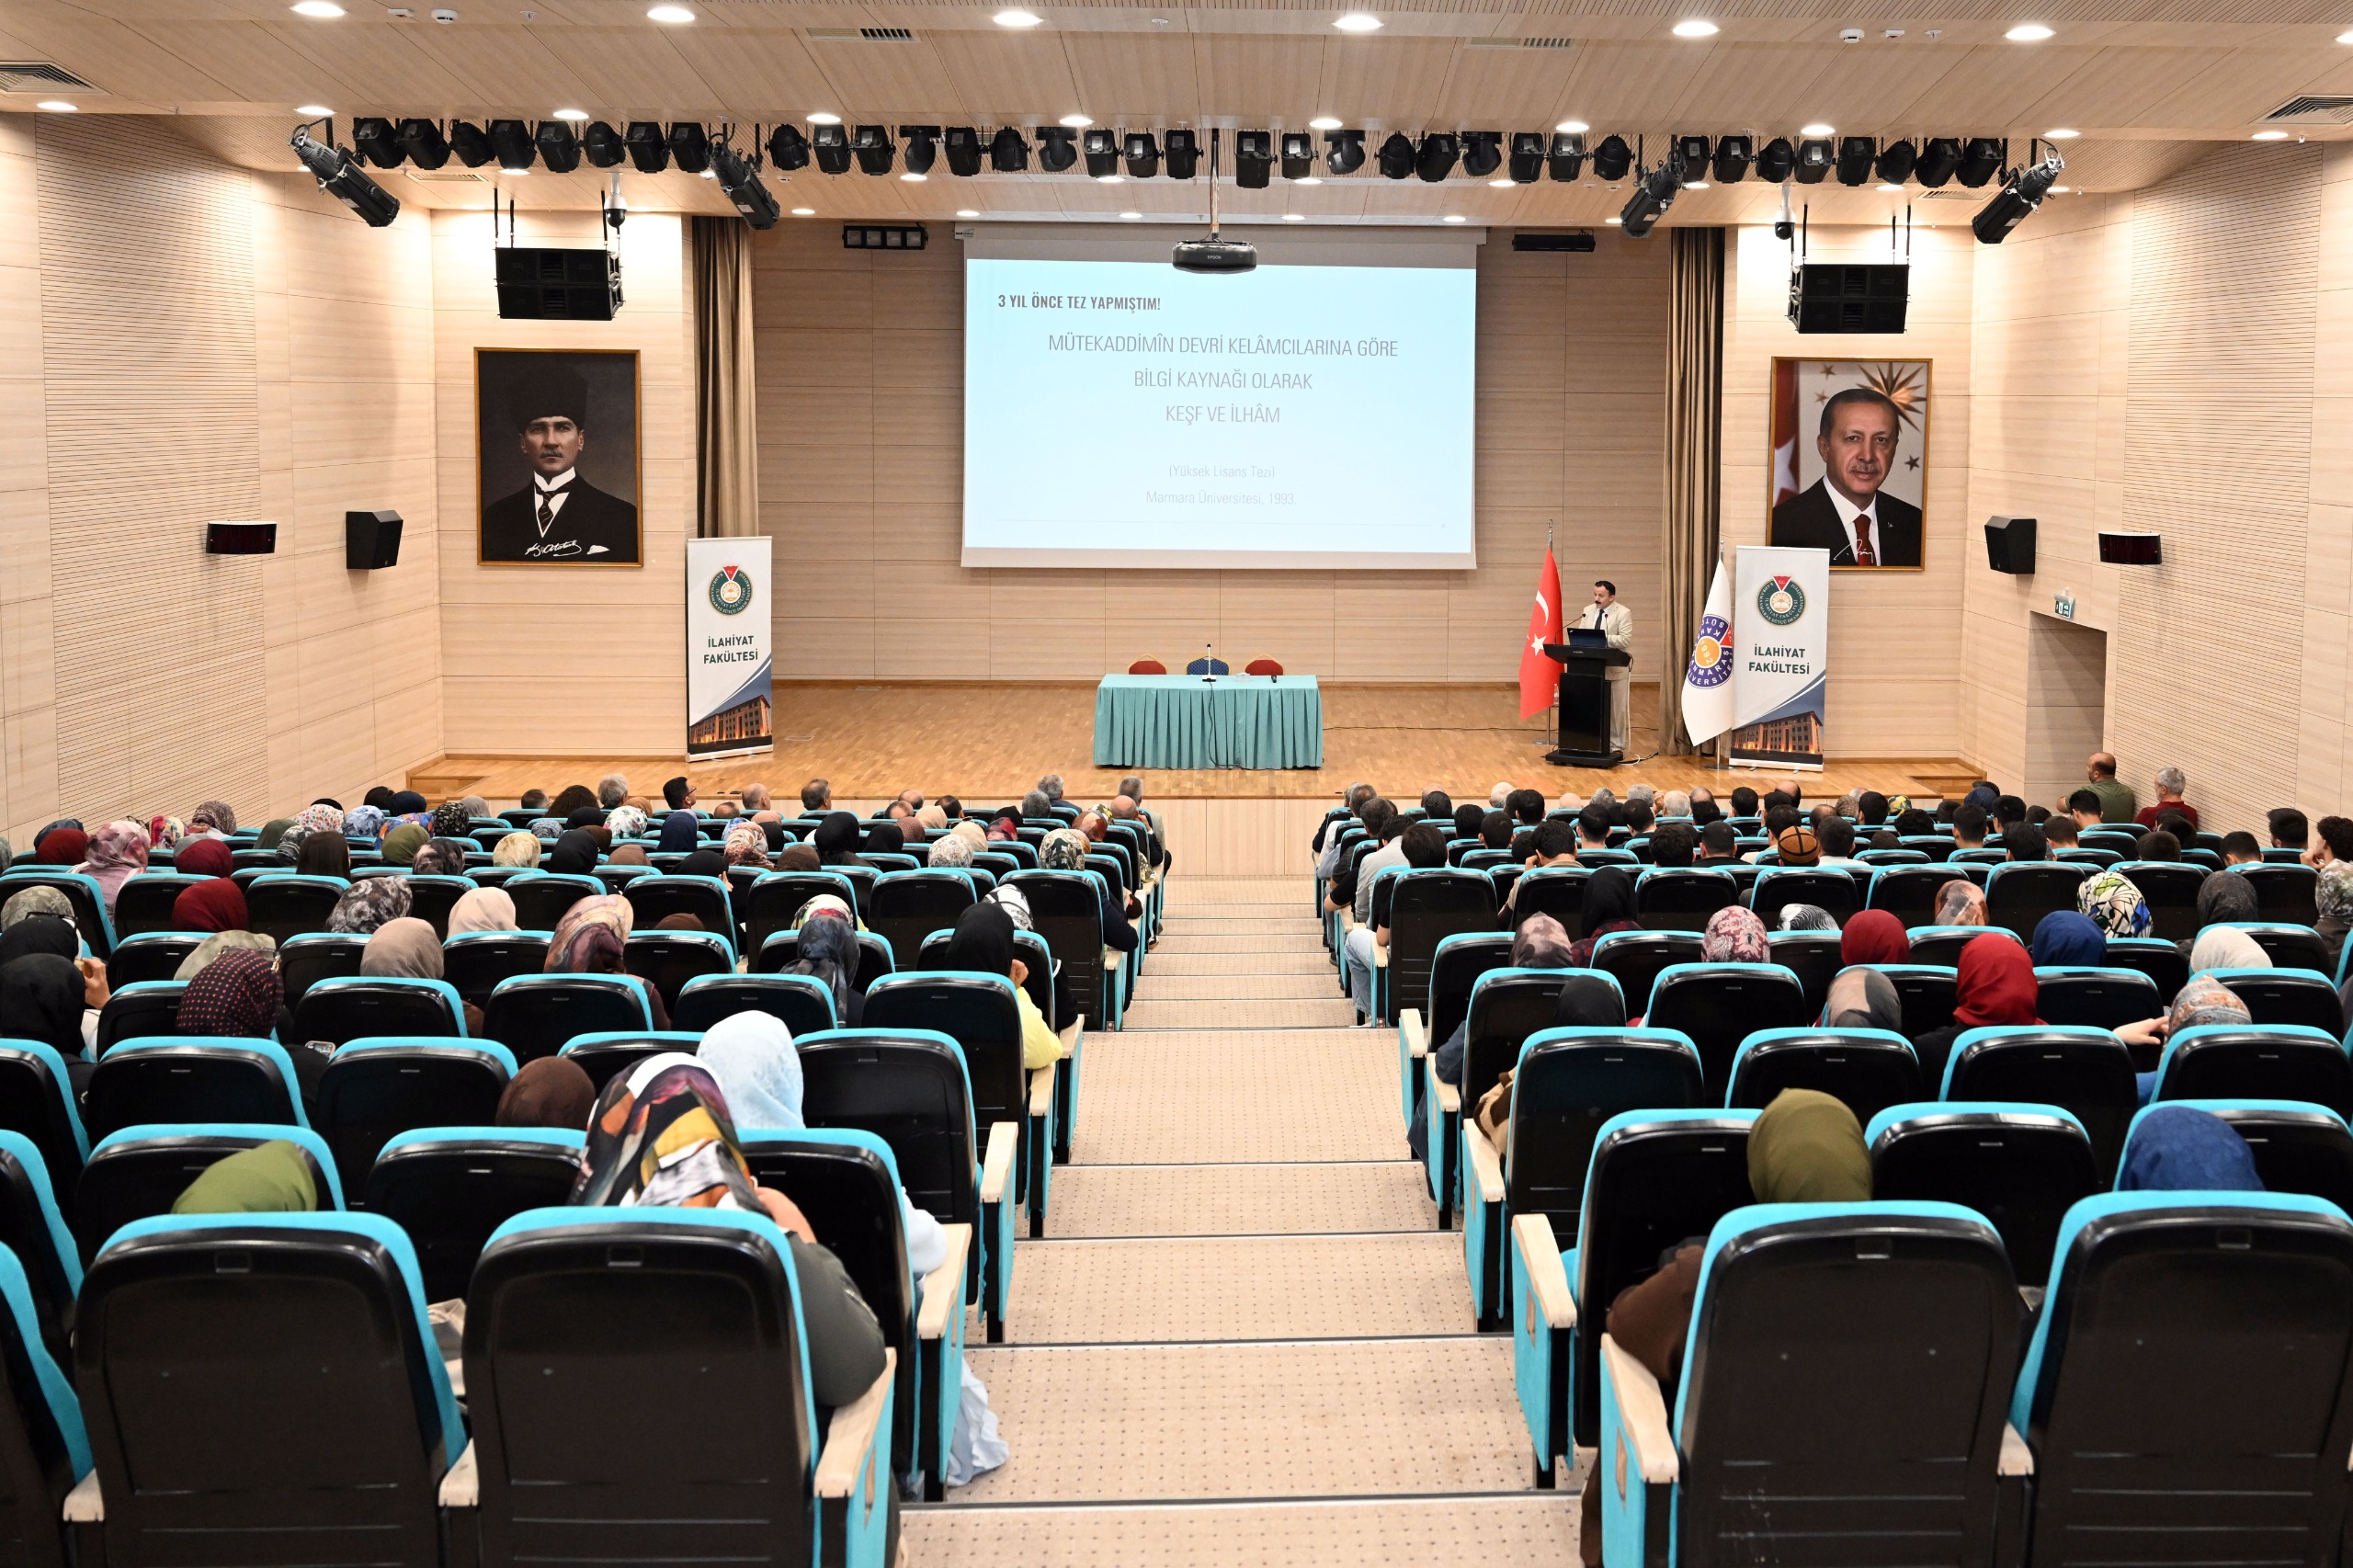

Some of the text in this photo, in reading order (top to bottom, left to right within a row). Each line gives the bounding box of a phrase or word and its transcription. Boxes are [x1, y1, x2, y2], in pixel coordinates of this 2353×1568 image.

[997, 291, 1161, 314] 3 YIL ÖNCE TEZ YAPMIŞTIM!
[1048, 331, 1398, 357] MÜTEKADDİMÎN DEVRİ KELÂMCILARINA GÖRE
[1134, 368, 1313, 390] BİLGİ KAYNAĞI OLARAK
[1165, 403, 1280, 426] KEŞF VE İLHÂM
[1168, 464, 1276, 480] (Yüksek Lisans Tezi)
[1146, 489, 1298, 506] Marmara Üniversitesi, 1993.
[708, 634, 755, 648] İLAHİYAT
[703, 648, 758, 665] FAKÜLTESİ
[1699, 640, 1713, 665] 1992
[1754, 643, 1806, 658] İLAHİYAT
[1748, 660, 1810, 675] FAKÜLTESİ
